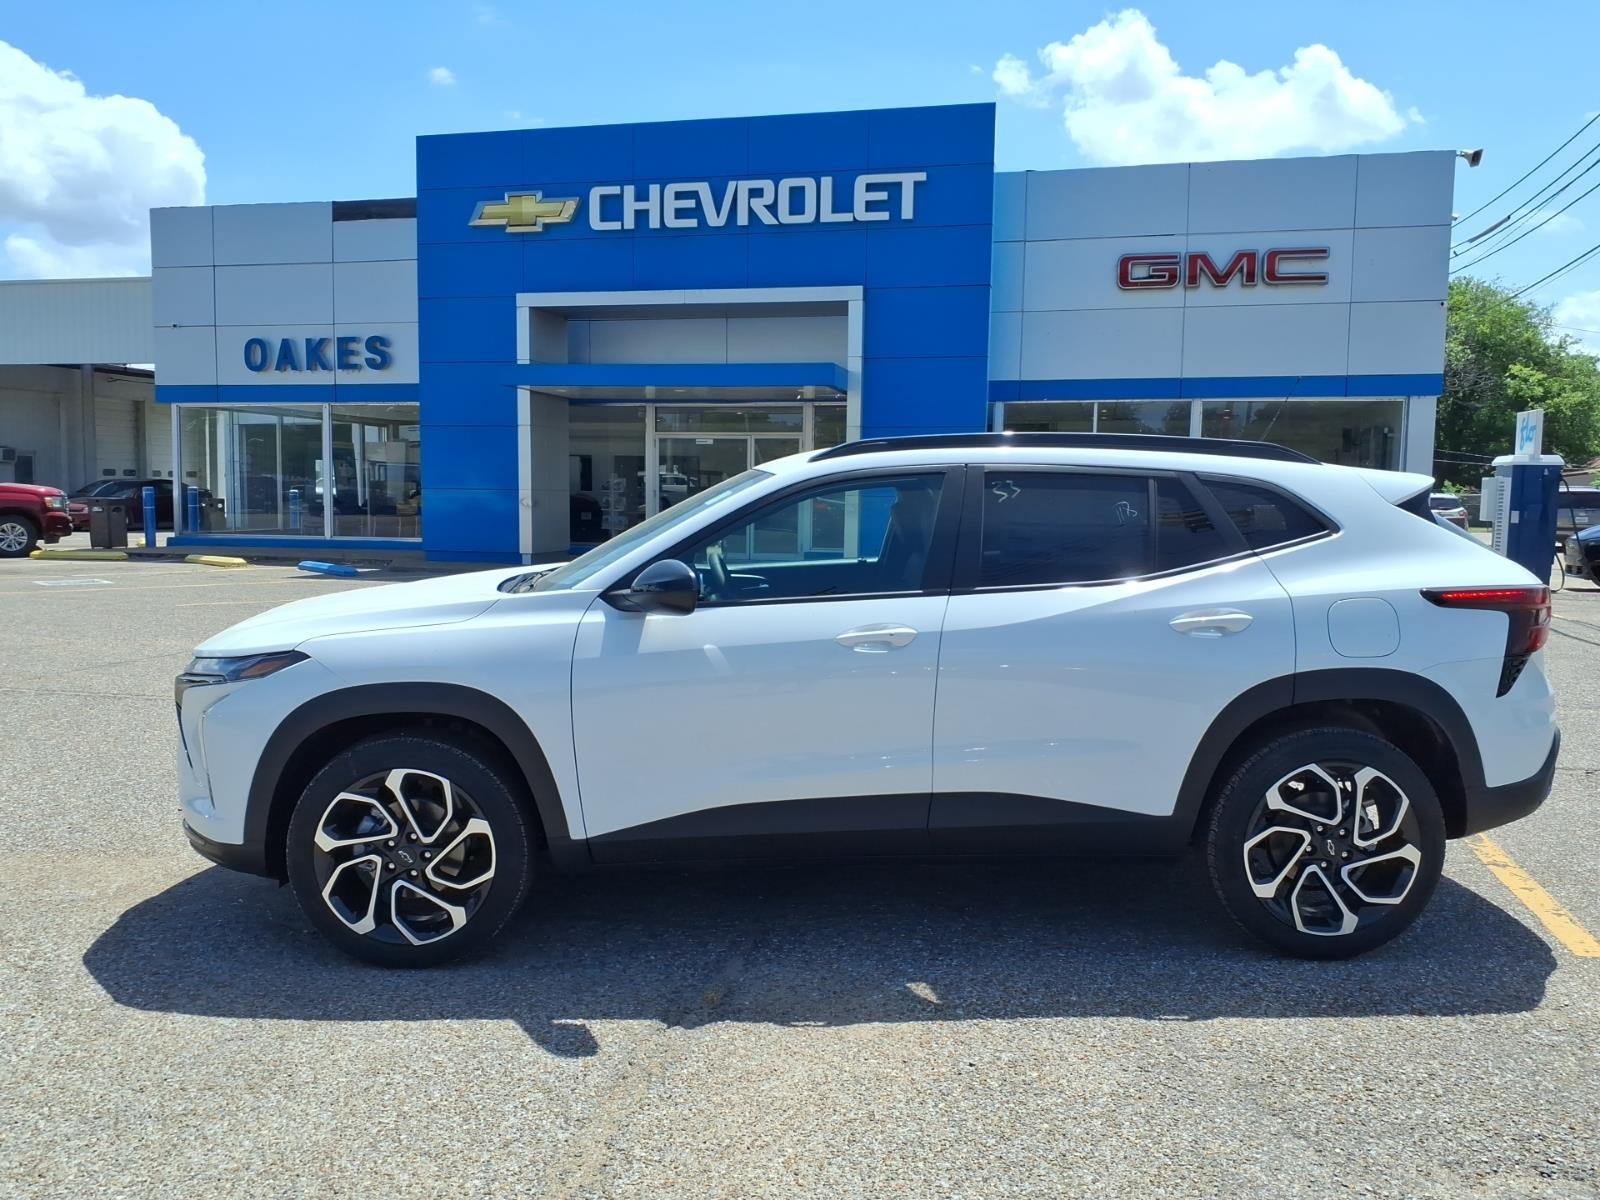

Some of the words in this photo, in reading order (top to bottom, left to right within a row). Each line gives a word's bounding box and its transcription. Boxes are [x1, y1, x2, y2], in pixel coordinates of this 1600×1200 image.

[589, 171, 927, 231] CHEVROLET
[1117, 248, 1330, 290] GMC
[244, 336, 391, 372] OAKES
